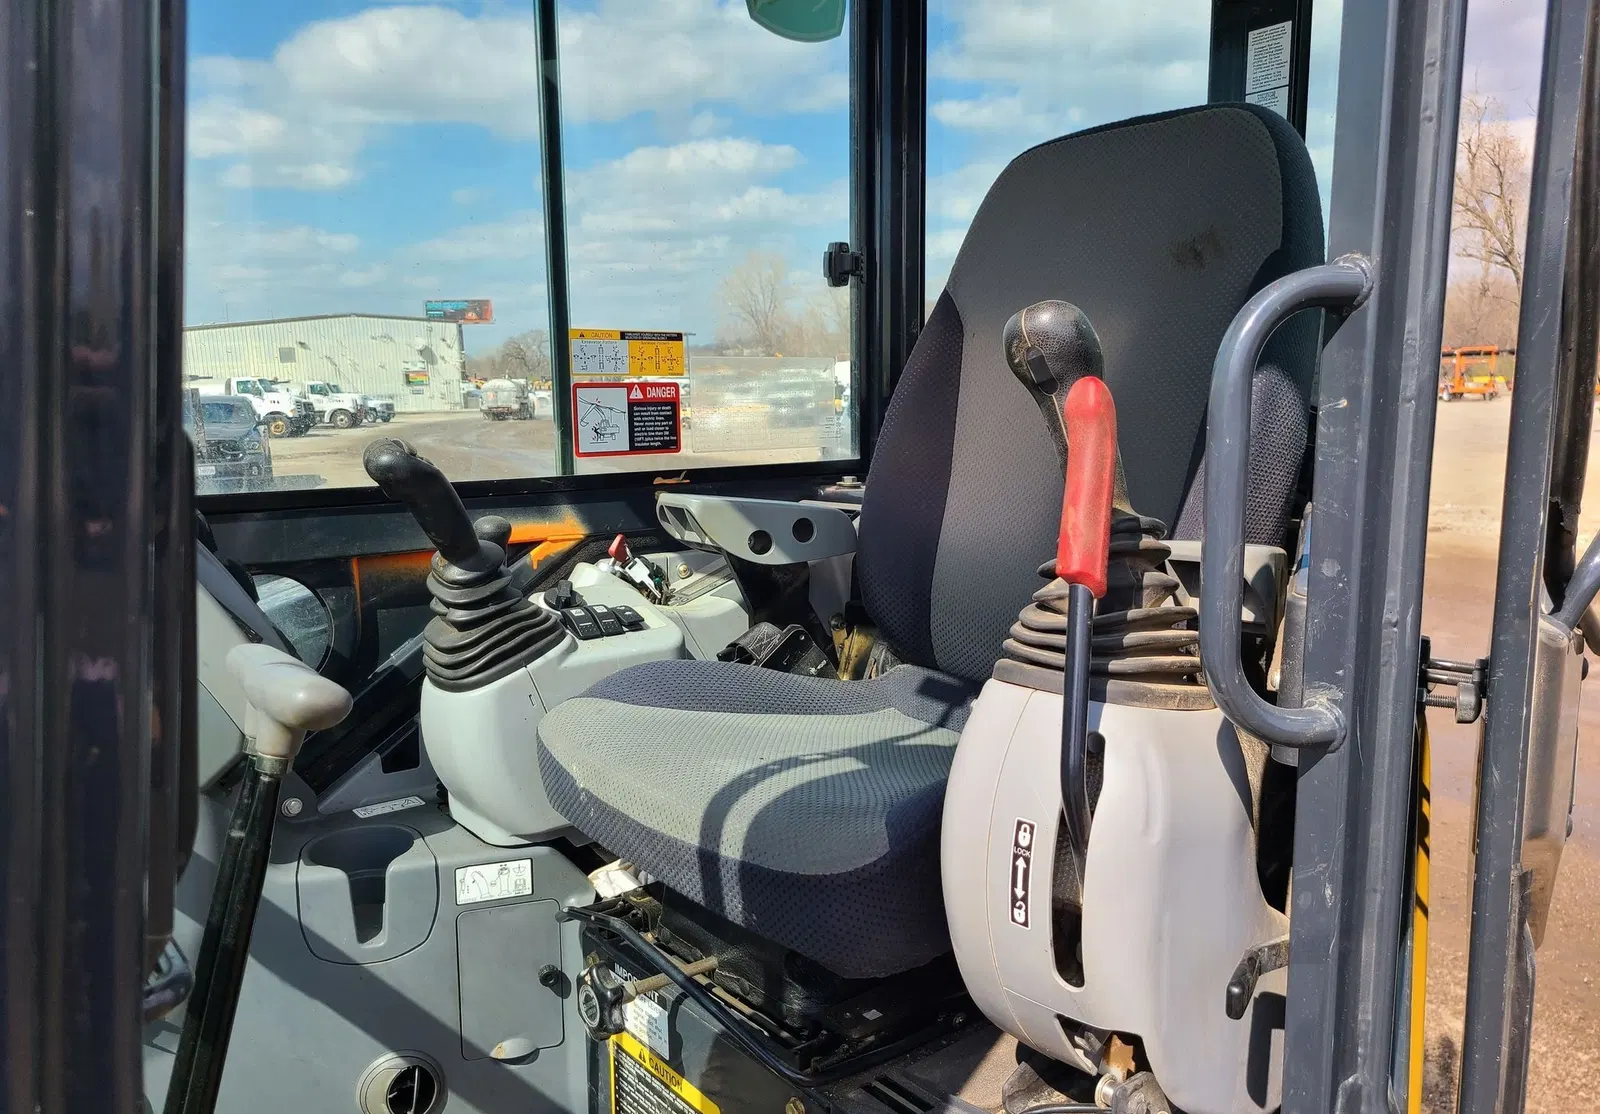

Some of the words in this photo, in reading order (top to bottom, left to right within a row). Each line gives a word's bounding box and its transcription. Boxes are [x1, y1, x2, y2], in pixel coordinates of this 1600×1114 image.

[647, 386, 676, 398] DANGER
[1014, 846, 1030, 858] LOCK
[649, 1057, 683, 1092] CAUTION
